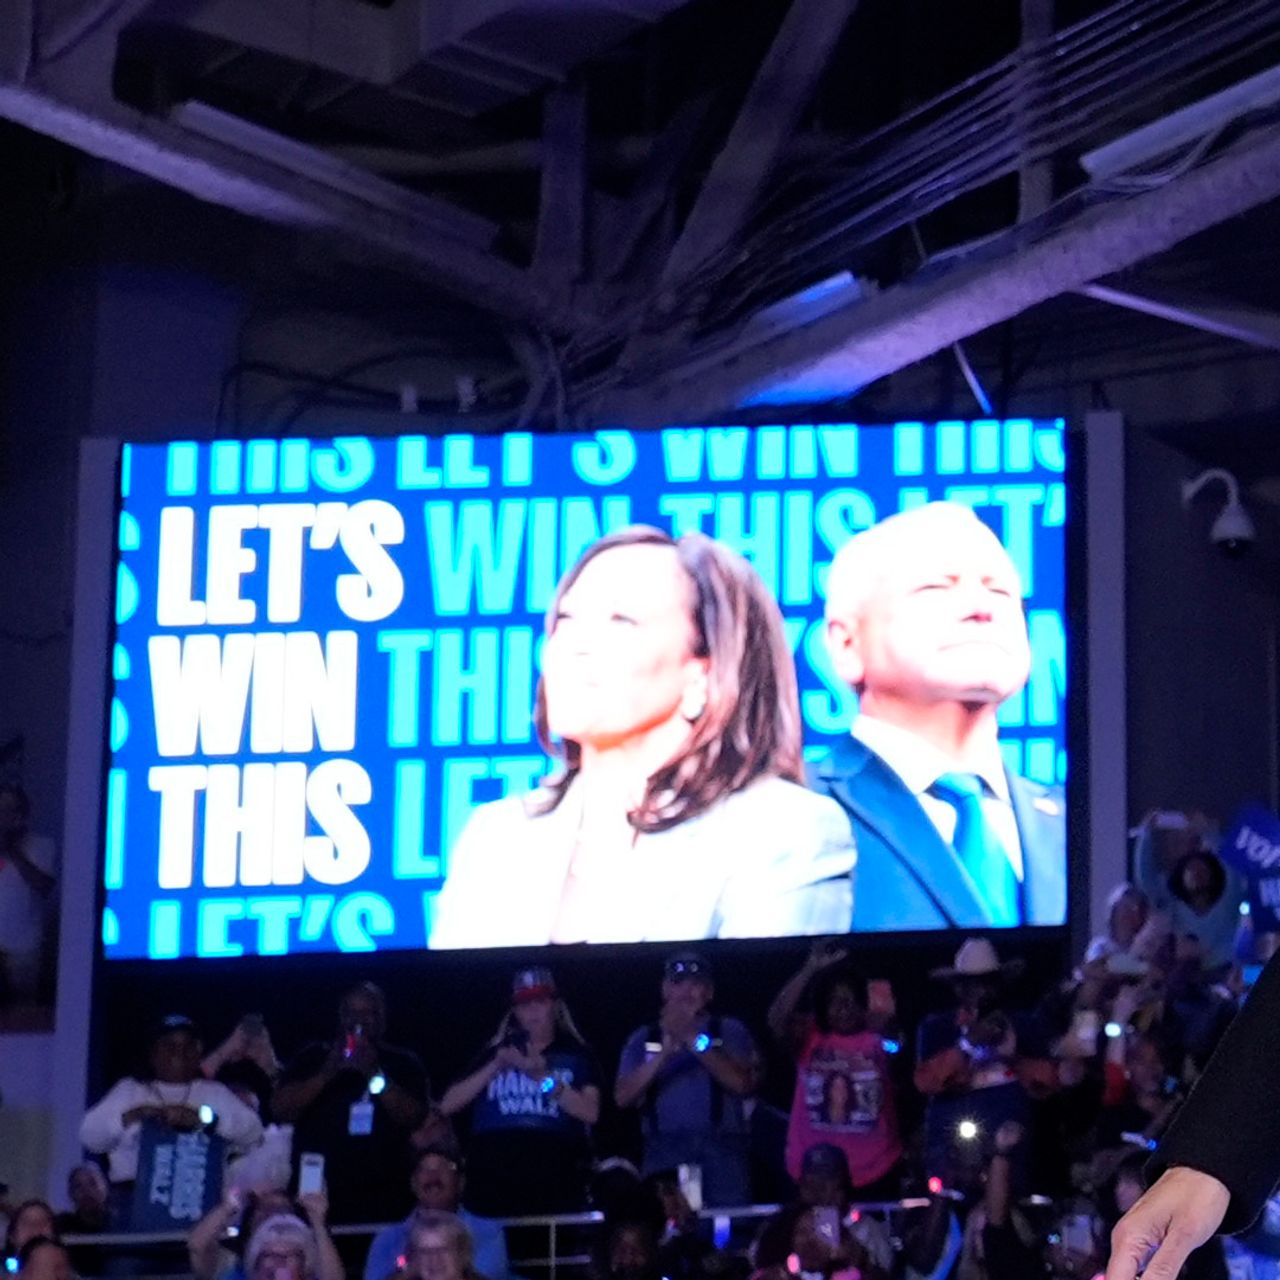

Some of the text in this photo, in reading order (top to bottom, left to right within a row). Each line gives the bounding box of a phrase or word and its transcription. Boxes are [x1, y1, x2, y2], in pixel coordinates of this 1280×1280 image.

[156, 499, 405, 626] LET'S
[147, 630, 359, 757] WIN
[376, 625, 548, 749] THI
[147, 758, 373, 889] THIS
